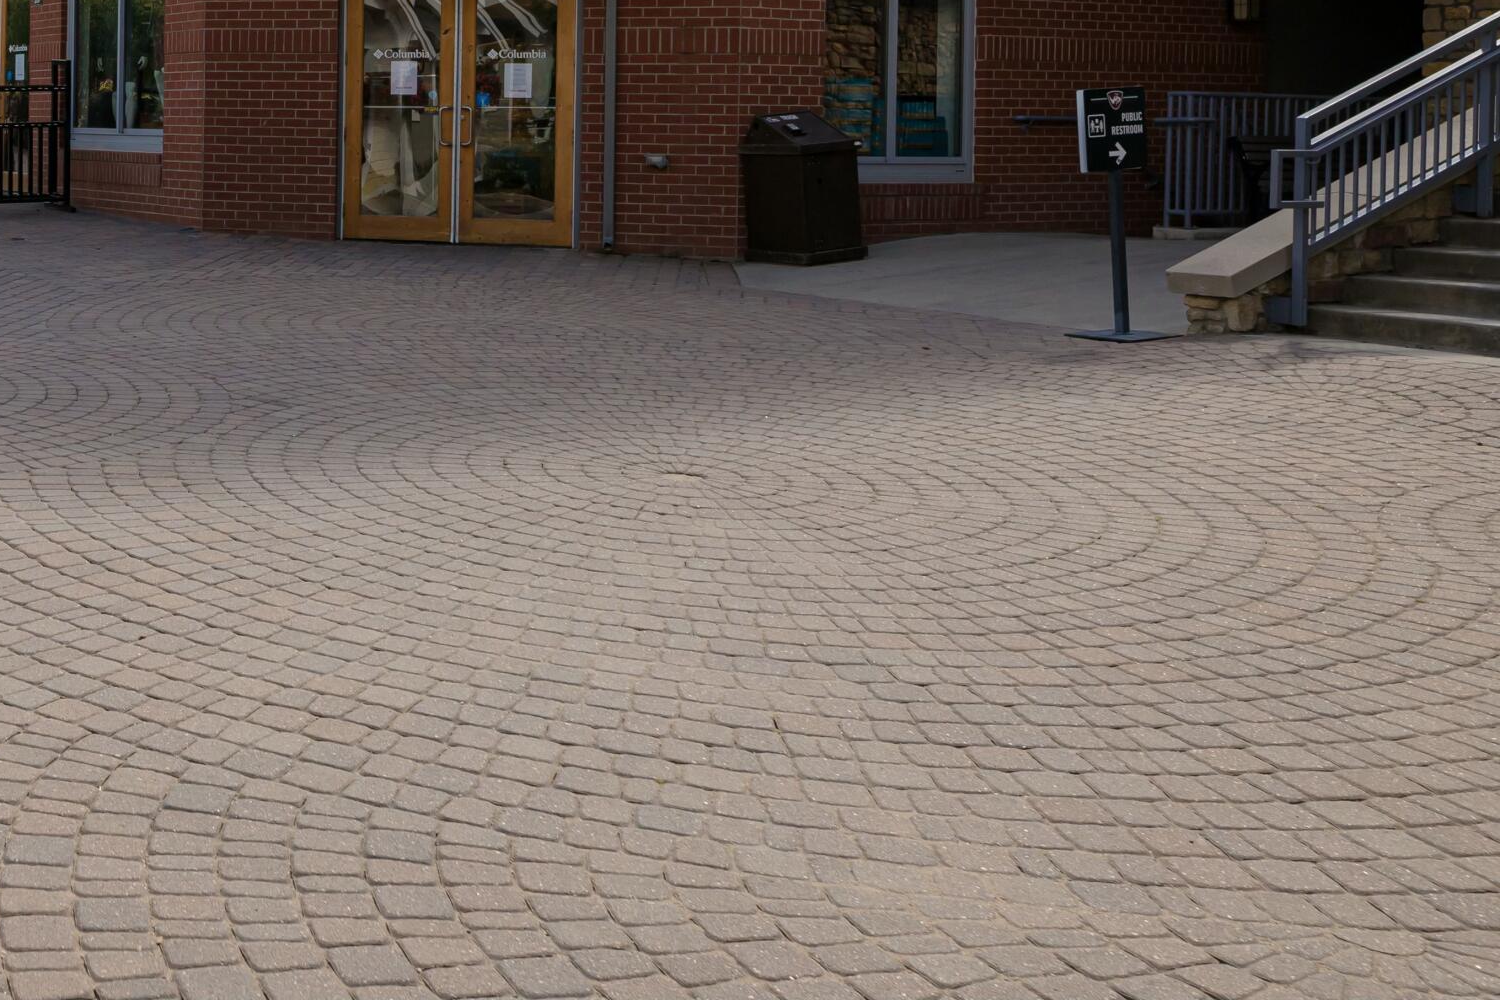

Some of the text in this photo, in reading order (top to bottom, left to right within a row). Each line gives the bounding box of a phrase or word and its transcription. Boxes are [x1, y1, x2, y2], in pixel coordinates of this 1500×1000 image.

[384, 49, 430, 59] Columbia
[499, 49, 547, 59] Columbia
[1121, 111, 1143, 122] PUBLIC
[1111, 124, 1143, 135] RESTROOM
